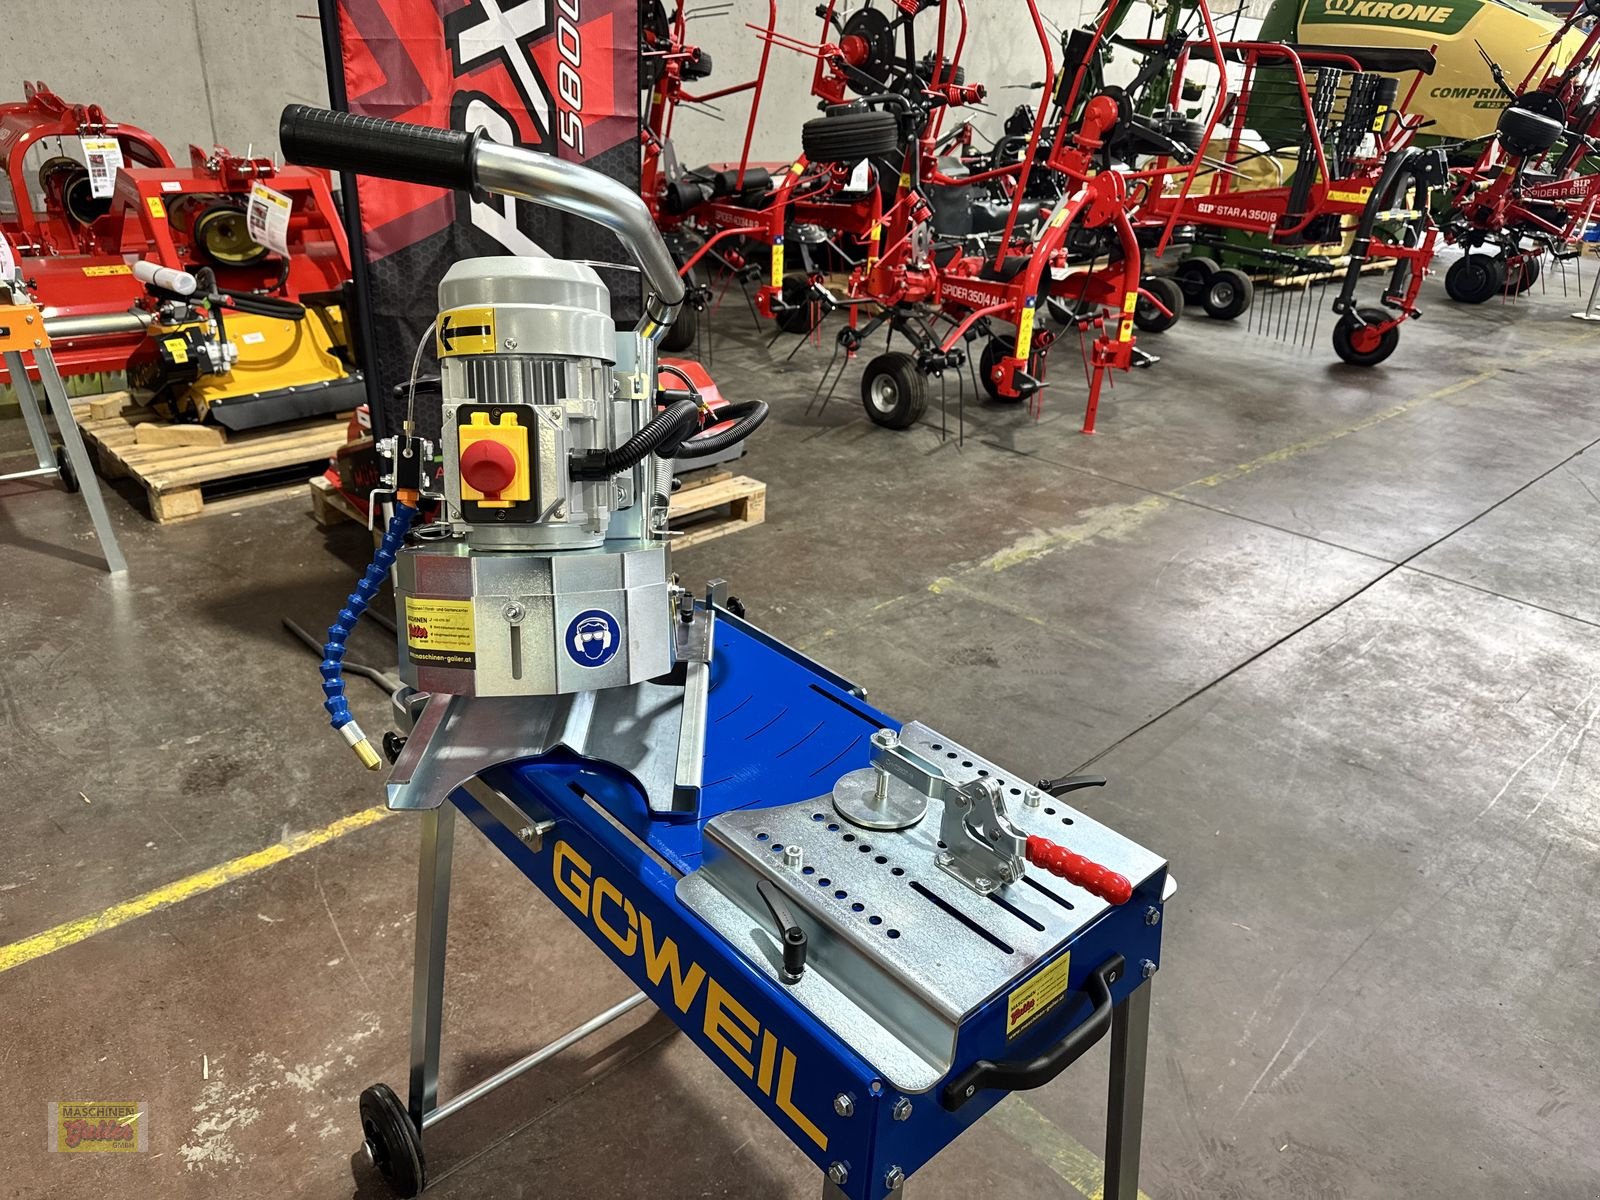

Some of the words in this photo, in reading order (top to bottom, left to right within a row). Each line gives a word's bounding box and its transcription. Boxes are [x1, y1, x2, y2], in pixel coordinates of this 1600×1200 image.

[1350, 1, 1455, 24] KRONE
[1430, 87, 1513, 99] COMPRIM
[1572, 179, 1591, 187] SIP
[1561, 188, 1567, 196] R
[1197, 203, 1214, 214] SIP
[1216, 205, 1240, 217] STAR
[1240, 209, 1247, 218] A
[941, 283, 968, 299] SPIDER
